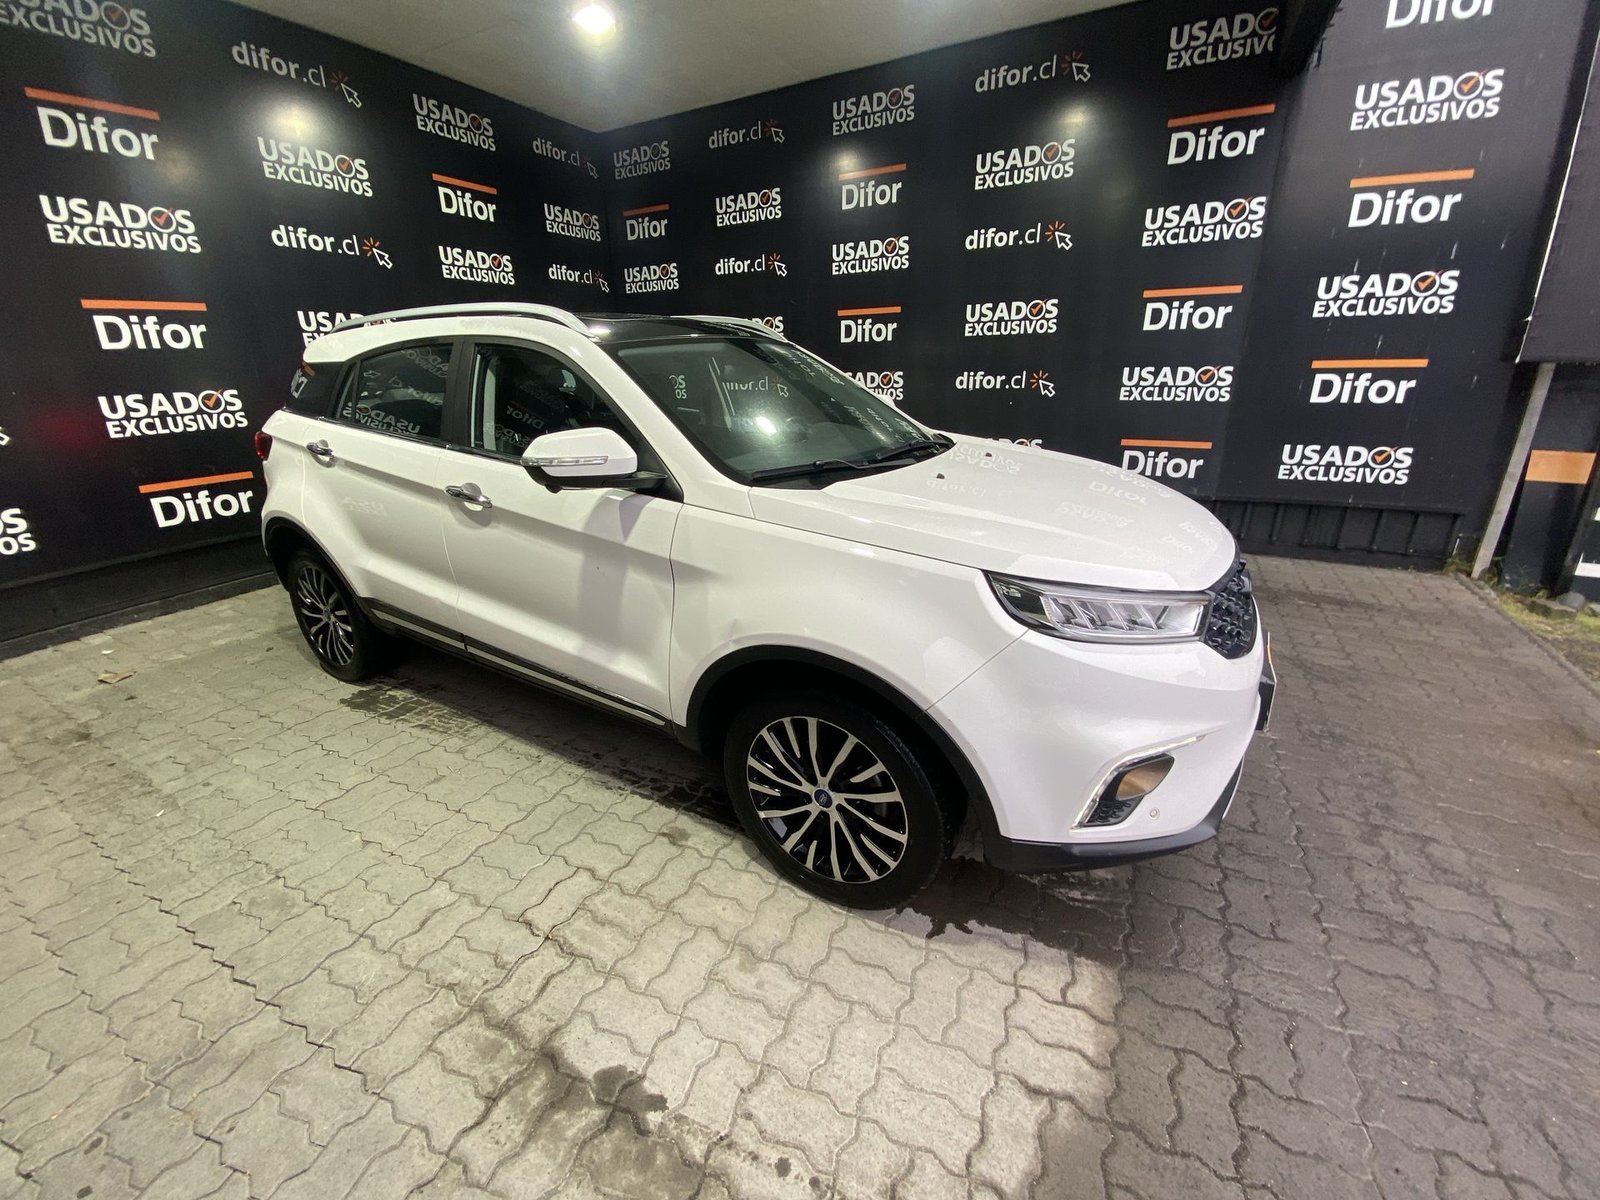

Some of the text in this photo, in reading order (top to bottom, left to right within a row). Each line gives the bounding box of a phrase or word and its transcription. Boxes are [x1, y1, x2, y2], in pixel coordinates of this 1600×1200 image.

[0, 0, 150, 35] ADOS
[1169, 8, 1279, 50] USADO
[231, 41, 326, 88] difor.cl
[975, 54, 1057, 93] difor.cl
[832, 84, 915, 121] USADOS
[1355, 69, 1505, 110] USADOS
[412, 94, 494, 136] USADOS
[832, 105, 915, 136] EXCLUSIVOS
[1350, 97, 1500, 131] EXCLUSIVOS
[36, 106, 159, 160] Difor
[416, 115, 496, 151] EXCLUSIVOS
[708, 121, 762, 149] difor.cl
[1167, 125, 1264, 166] Difor
[257, 136, 369, 180] USADOS
[532, 138, 581, 166] difor.cl
[613, 140, 670, 167] USADOS
[975, 139, 1076, 174] USADOS
[262, 161, 373, 197] EXCLUSIVOS
[614, 158, 671, 180] EXCLUSIVOS
[974, 161, 1074, 191] EXCLUSIVOS
[438, 186, 496, 222] Difor
[715, 188, 782, 215] USADOS
[841, 180, 902, 211] Difor
[1348, 189, 1462, 228] Difor
[39, 195, 196, 234] USADOS
[543, 203, 600, 230] USADOS
[716, 205, 782, 227] EXCLUSIVOS
[1144, 196, 1267, 231] USADOS
[46, 223, 201, 253] EXCLUSIVOS
[271, 225, 360, 256] difor.cl
[546, 220, 601, 242] EXCLUSIVOS
[625, 217, 668, 241] Difor
[964, 223, 1041, 251] difor.cl
[1141, 220, 1263, 248] EXCLUSIVOS
[438, 245, 513, 272] USADOS
[832, 236, 909, 262] USADOS
[441, 264, 515, 286] EXCLUSIVOS
[548, 264, 593, 285] difor.cl
[624, 263, 679, 283] USADOS
[715, 254, 766, 276] difor.cl
[832, 255, 909, 275] EXCLUSIVOS
[625, 278, 679, 294] EXCLUSIVOS
[1317, 269, 1460, 300] USADOS
[965, 299, 1058, 323] USADOS
[1143, 300, 1232, 331] Difor
[1312, 294, 1454, 318] EXCLUSIVOS
[93, 314, 207, 350] Difor
[840, 318, 897, 343] Difor
[964, 318, 1057, 337] EXCLUSIVOS
[955, 371, 1026, 391] difor.cl
[1122, 365, 1234, 387] USADOS
[1309, 372, 1416, 404] Difor
[98, 389, 243, 420] USADOS
[1119, 384, 1231, 402] EXCLUSIVOS
[105, 412, 248, 439] EXCLUSIVOS
[1121, 450, 1203, 479] Difor
[1281, 444, 1413, 469] USADOS
[1278, 463, 1409, 485] EXCLUSIVOS
[150, 490, 254, 528] Difor
